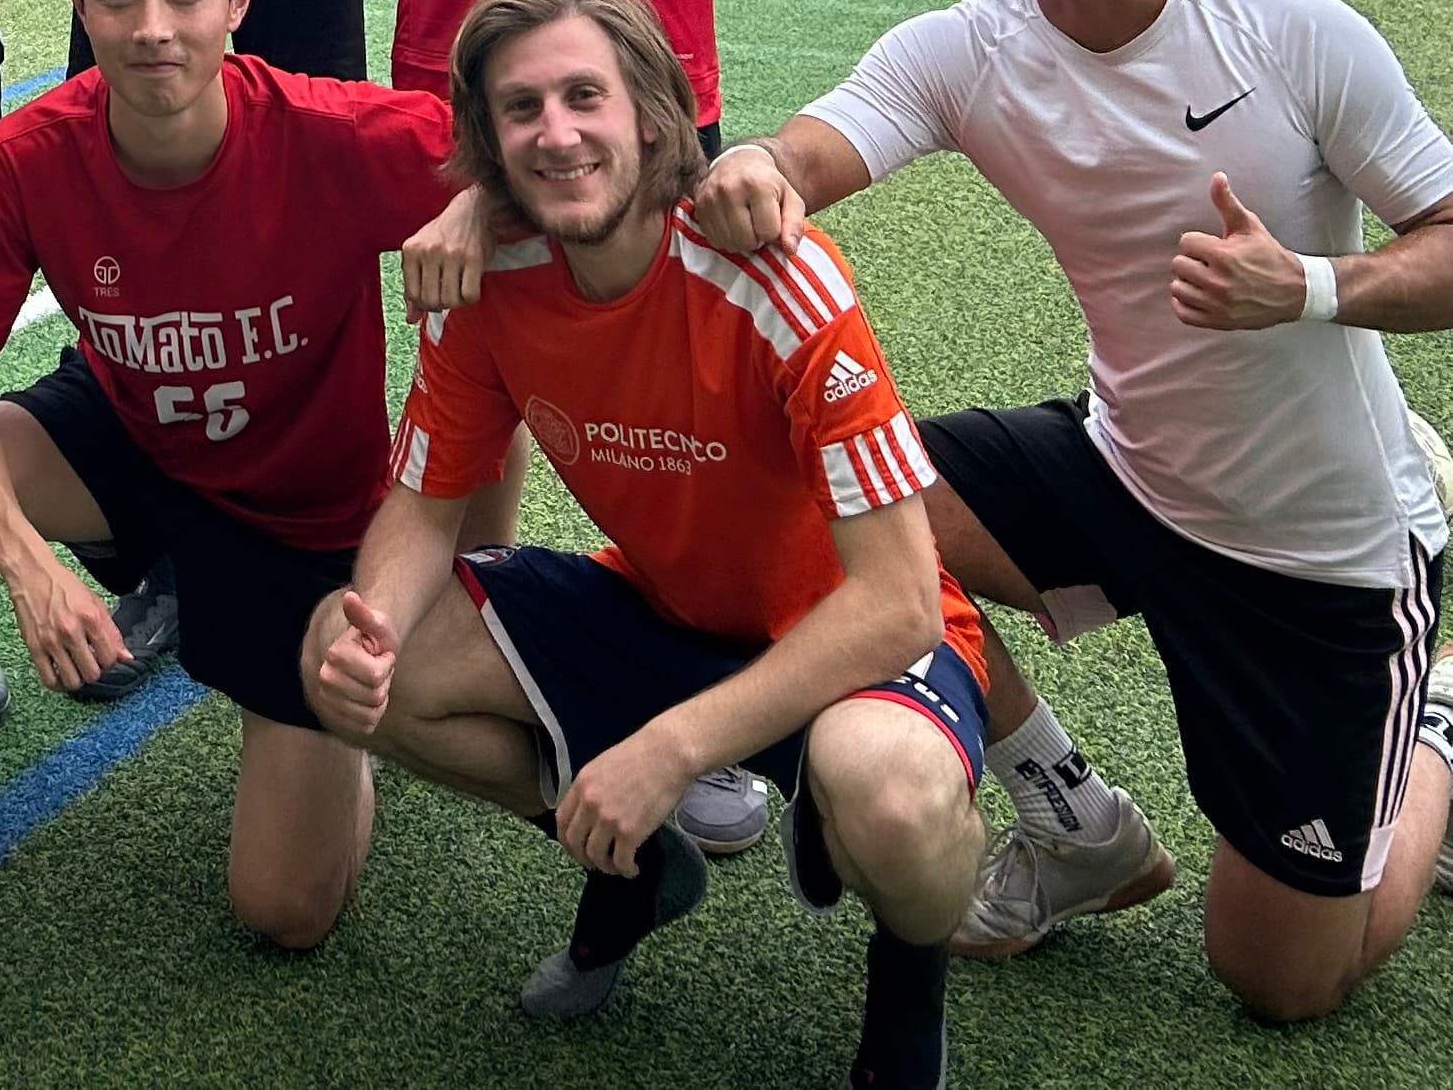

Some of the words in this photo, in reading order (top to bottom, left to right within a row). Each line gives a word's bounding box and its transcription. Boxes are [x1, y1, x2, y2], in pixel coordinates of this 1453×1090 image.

[94, 287, 120, 298] TRES
[235, 295, 309, 365] F.C.
[824, 369, 877, 402] adidas
[585, 422, 727, 462] POLITECNCO
[591, 449, 655, 472] MILANO
[658, 455, 692, 475] 1863
[1281, 834, 1342, 862] adidas
